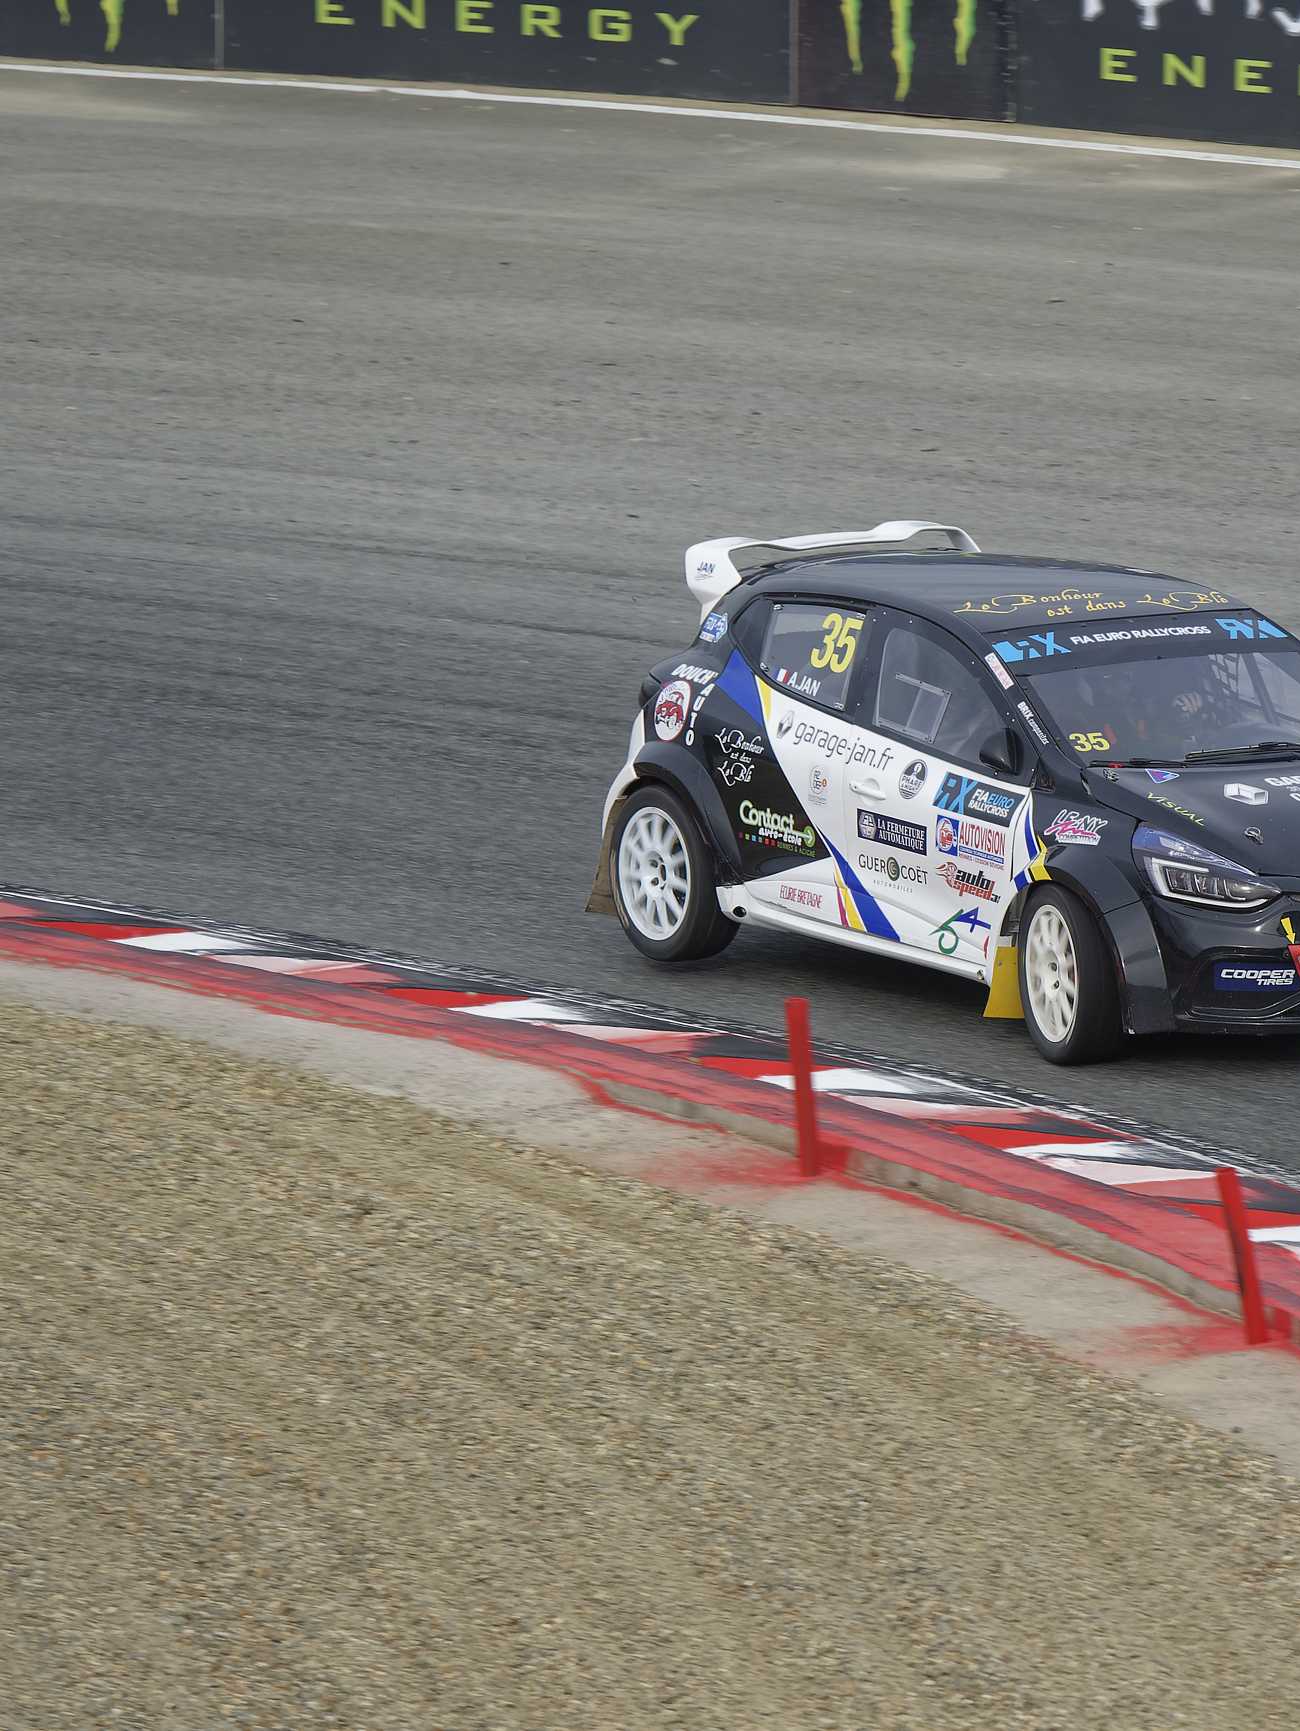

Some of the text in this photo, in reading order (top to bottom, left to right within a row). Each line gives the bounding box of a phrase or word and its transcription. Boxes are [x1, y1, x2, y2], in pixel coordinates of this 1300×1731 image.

[314, 0, 699, 46] ENERGY
[811, 612, 864, 674] 35
[1070, 636, 1095, 645] FIA
[1092, 630, 1132, 643] EURO
[1131, 625, 1212, 639] RALLYCROSS
[793, 722, 894, 771] garage-jan.fr
[1068, 732, 1110, 752] 35
[740, 800, 795, 833] Contact
[968, 800, 1009, 817] RALLYCROSS
[877, 818, 925, 840] LA FERMETURE
[879, 829, 924, 850] AUTOMATIQUE
[959, 821, 1006, 856] AUTOVISION
[955, 869, 992, 890] auto
[1221, 969, 1296, 979] COOPER
[1256, 978, 1293, 986] TIRES
